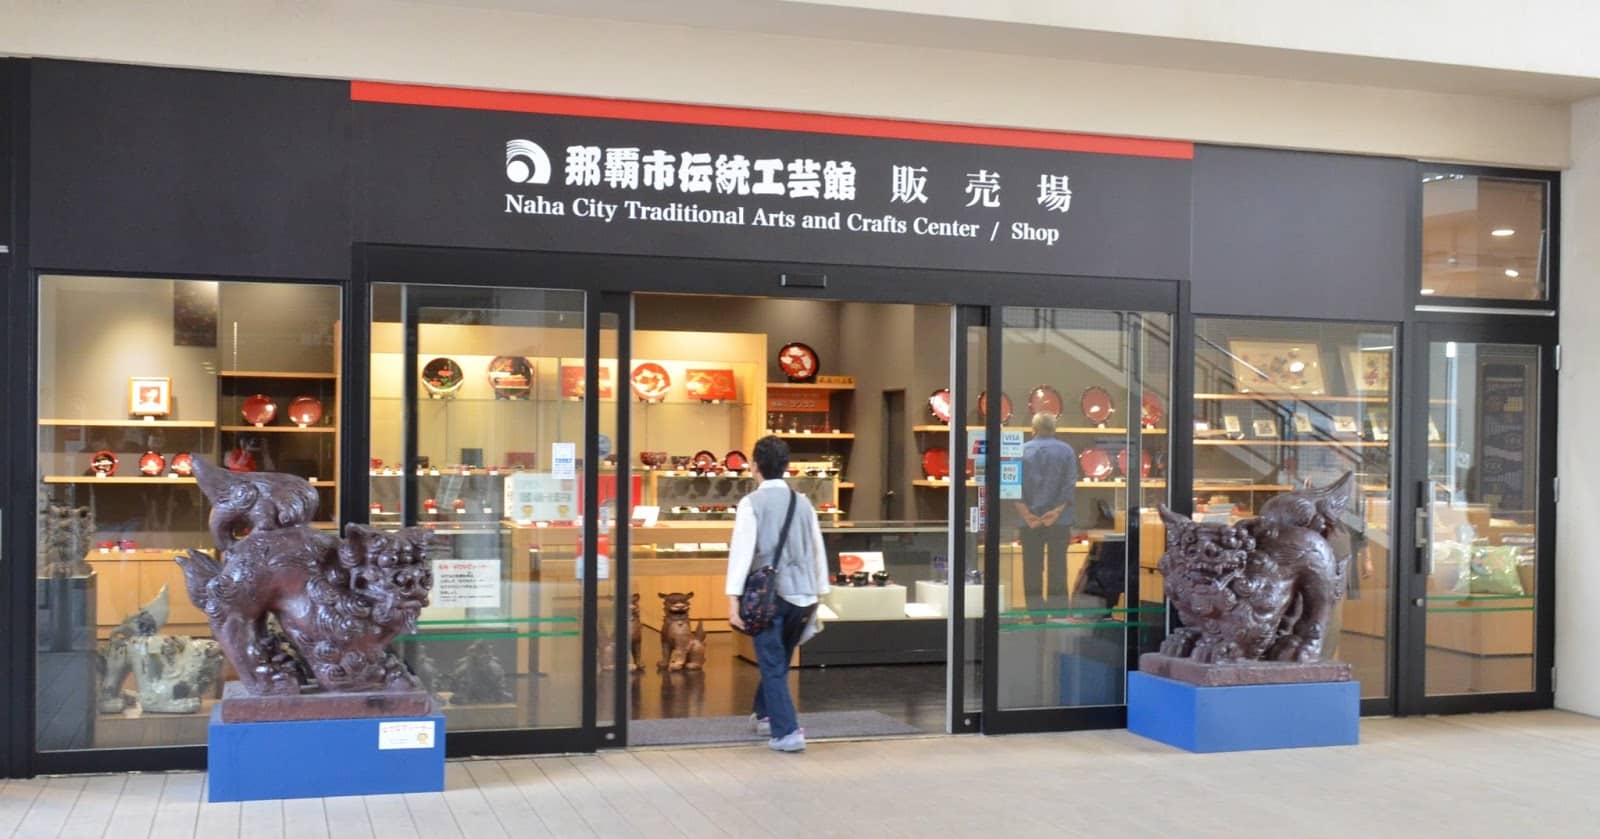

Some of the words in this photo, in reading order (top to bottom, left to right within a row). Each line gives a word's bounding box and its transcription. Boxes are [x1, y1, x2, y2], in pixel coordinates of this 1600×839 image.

[564, 145, 857, 201] 那覇市伝統工芸館
[504, 193, 565, 216] Naha
[572, 197, 618, 223] City
[624, 200, 745, 226] Traditional
[751, 207, 796, 228] Arts
[801, 212, 841, 231] and
[847, 213, 908, 234] Crafts
[912, 216, 981, 238] Center
[989, 221, 1001, 242] /
[1011, 221, 1060, 246] Shop
[1004, 433, 1020, 441] VISA
